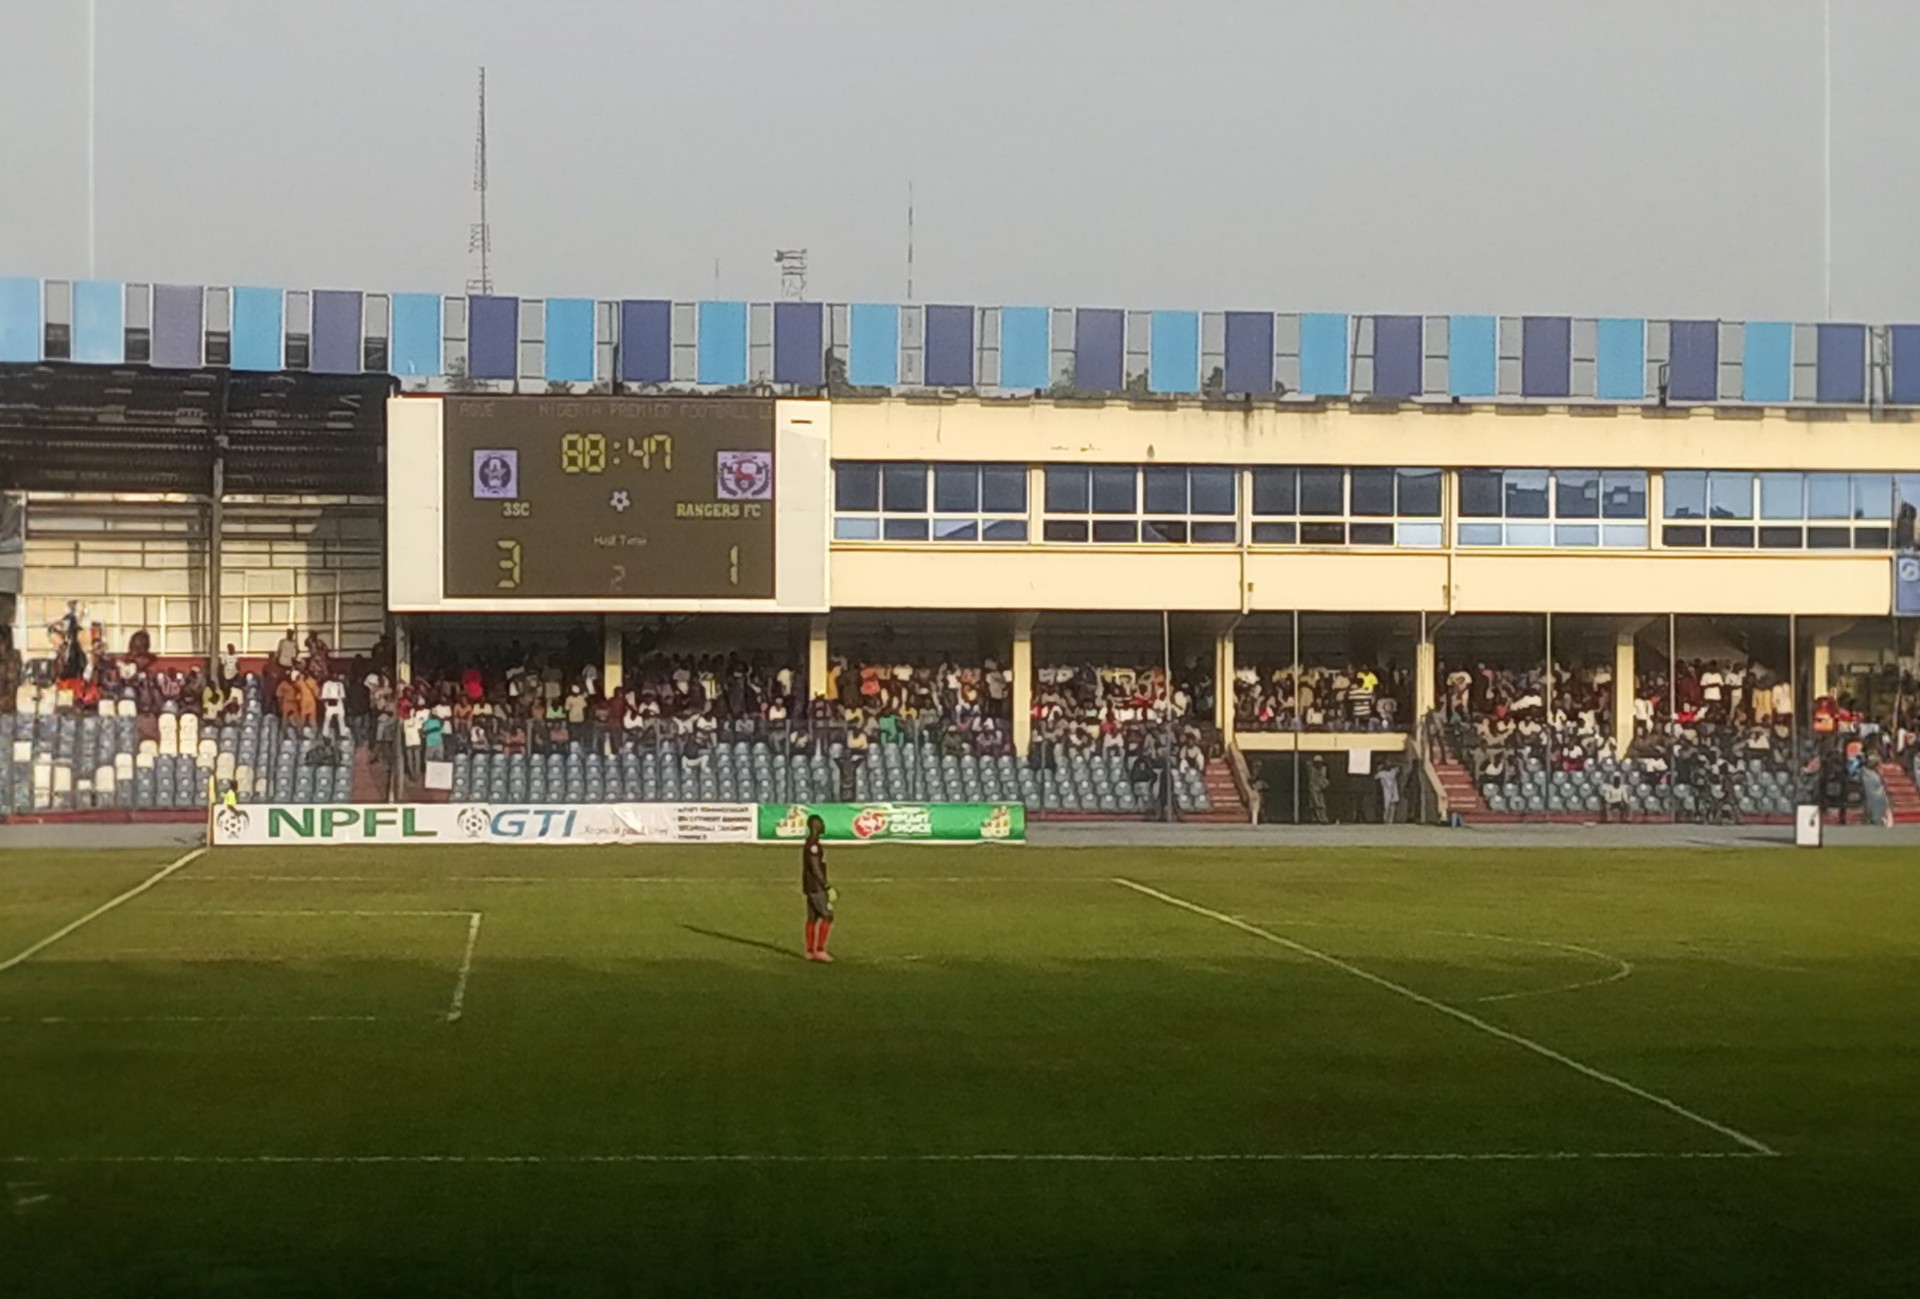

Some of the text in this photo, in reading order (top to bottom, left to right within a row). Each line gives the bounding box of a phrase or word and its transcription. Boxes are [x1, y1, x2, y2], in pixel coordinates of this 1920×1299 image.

[561, 433, 672, 473] 88:47
[502, 502, 531, 518] 3SC
[676, 503, 762, 518] RANGERS FC
[496, 539, 521, 588] 3
[730, 544, 739, 586] 1
[267, 807, 438, 839] NPFL
[490, 809, 577, 838] GTI
